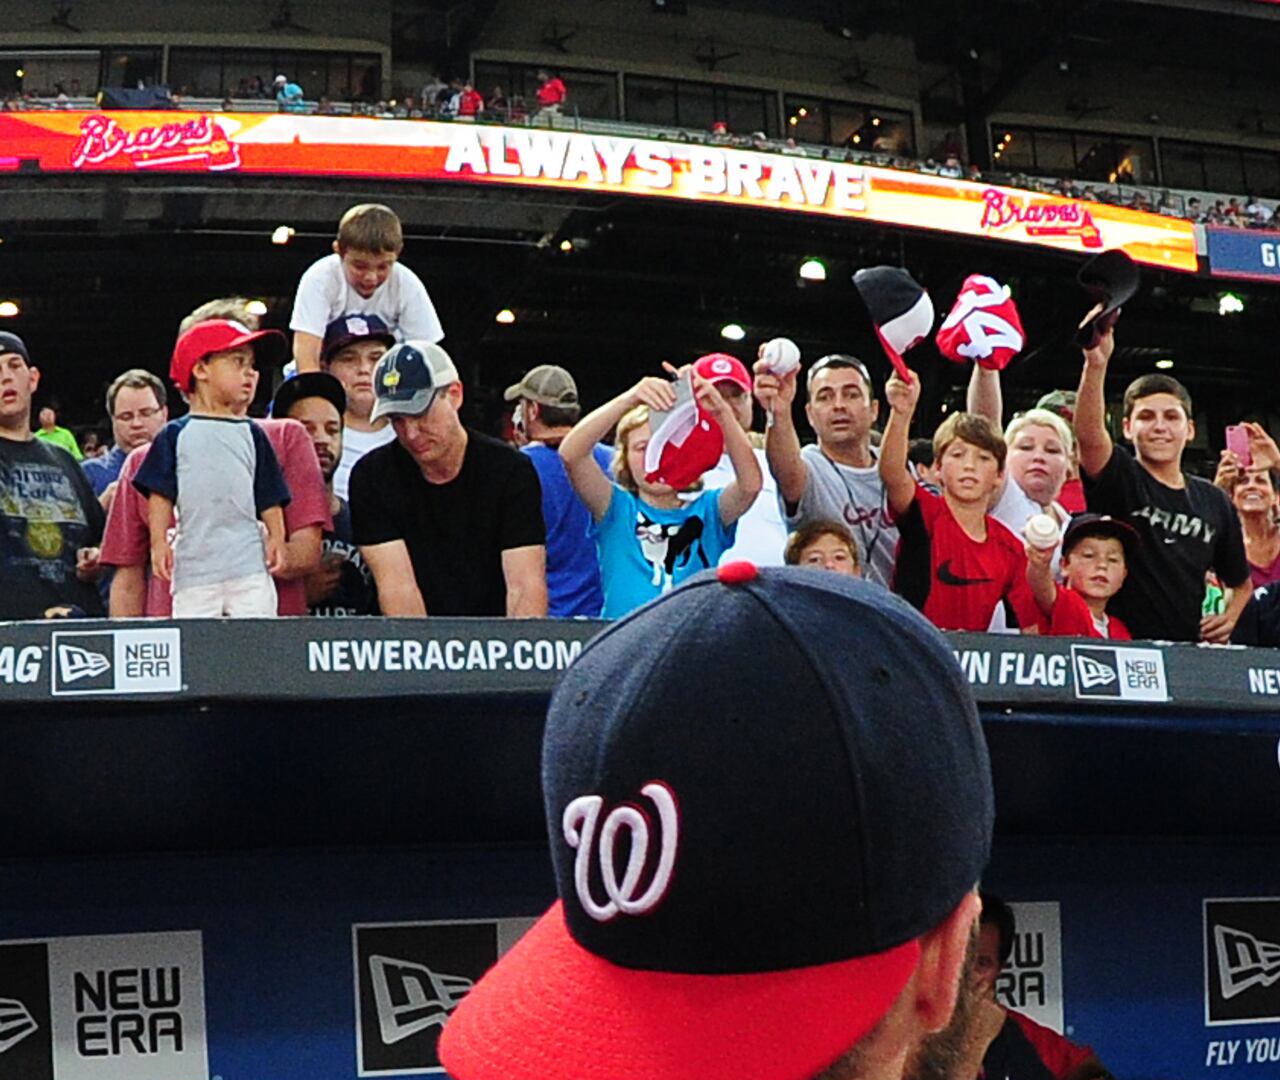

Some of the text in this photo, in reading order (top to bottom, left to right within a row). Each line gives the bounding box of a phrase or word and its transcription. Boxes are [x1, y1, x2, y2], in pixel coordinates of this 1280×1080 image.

[73, 114, 214, 168] Braves
[444, 130, 866, 211] ALWAYS BRAVE
[981, 189, 1083, 228] Braves
[125, 642, 170, 660] NEW
[307, 640, 581, 672] NEWERACAP.COM
[998, 651, 1066, 687] FLAG
[1125, 659, 1158, 675] NEW
[125, 660, 170, 679] ERA
[1126, 673, 1159, 691] ERA
[562, 781, 678, 921] W
[73, 965, 182, 1013] NEW
[995, 971, 1045, 1007] RA
[75, 1010, 184, 1057] ERA
[1206, 1039, 1238, 1067] FLY
